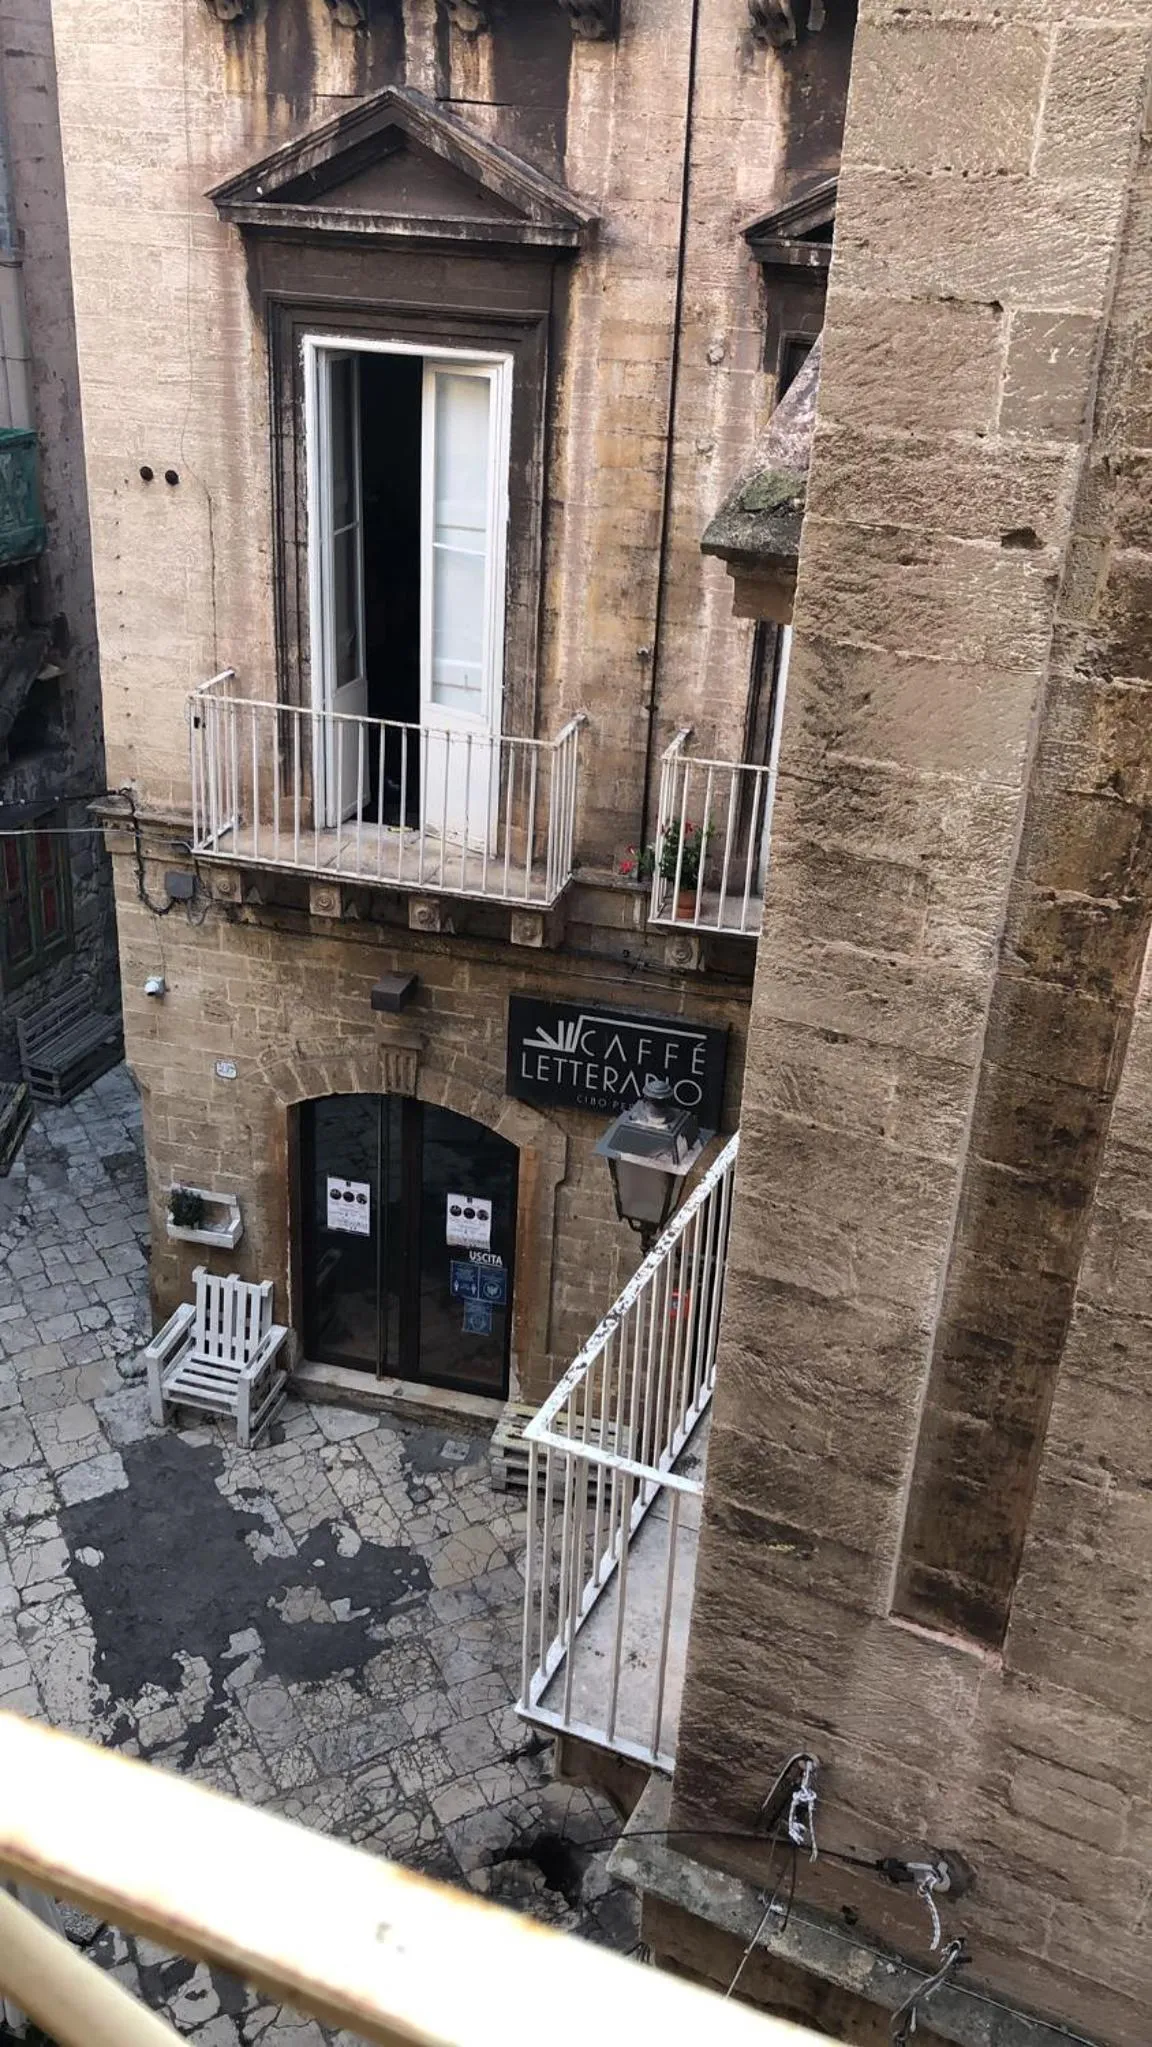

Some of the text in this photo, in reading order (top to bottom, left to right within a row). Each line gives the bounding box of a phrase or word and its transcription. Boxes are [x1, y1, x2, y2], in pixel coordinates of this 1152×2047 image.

[580, 1030, 706, 1075] CAFFÉ
[576, 1094, 607, 1108] CIBO
[468, 1250, 503, 1266] USCITA
